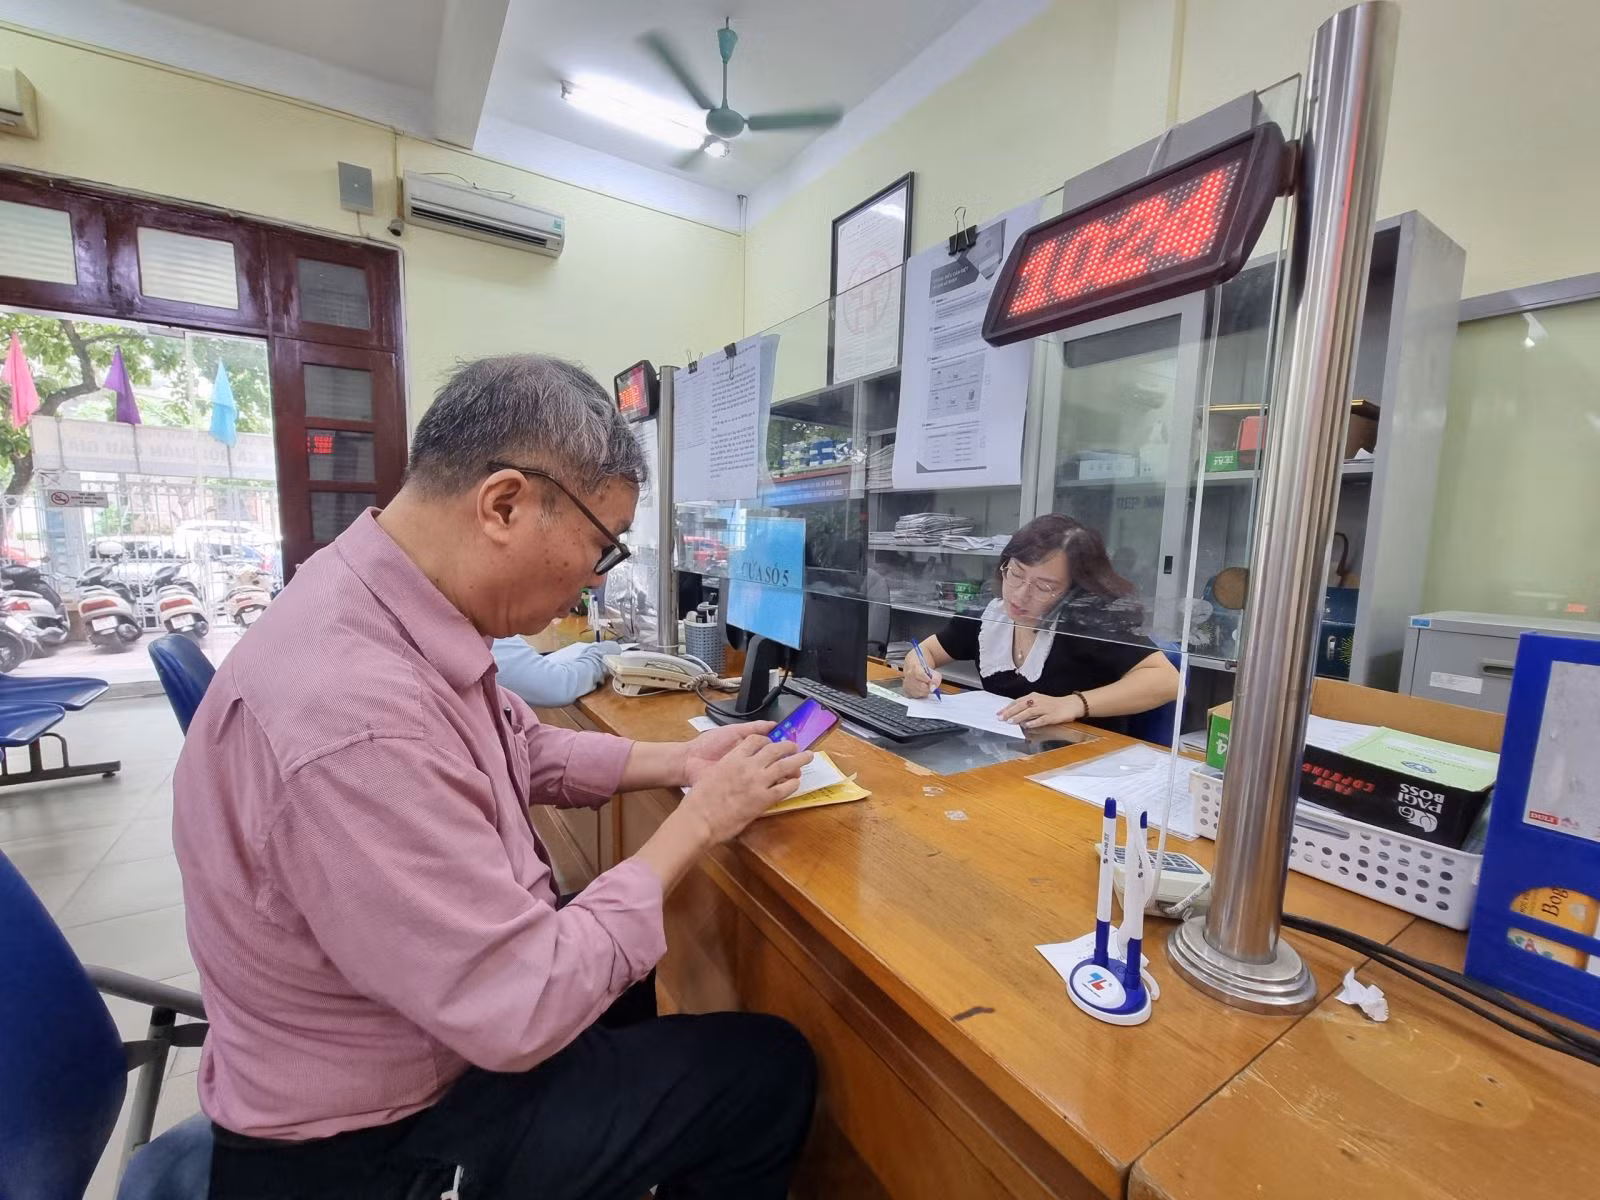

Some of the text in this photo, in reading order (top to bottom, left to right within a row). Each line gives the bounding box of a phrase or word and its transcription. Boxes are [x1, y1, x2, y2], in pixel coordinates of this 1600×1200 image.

[1008, 168, 1226, 316] 1024
[782, 570, 789, 587] 5
[1301, 762, 1376, 793] COPYING
[1313, 777, 1354, 796] FAST
[1397, 791, 1442, 814] PAGI
[1399, 783, 1445, 804] BOSS
